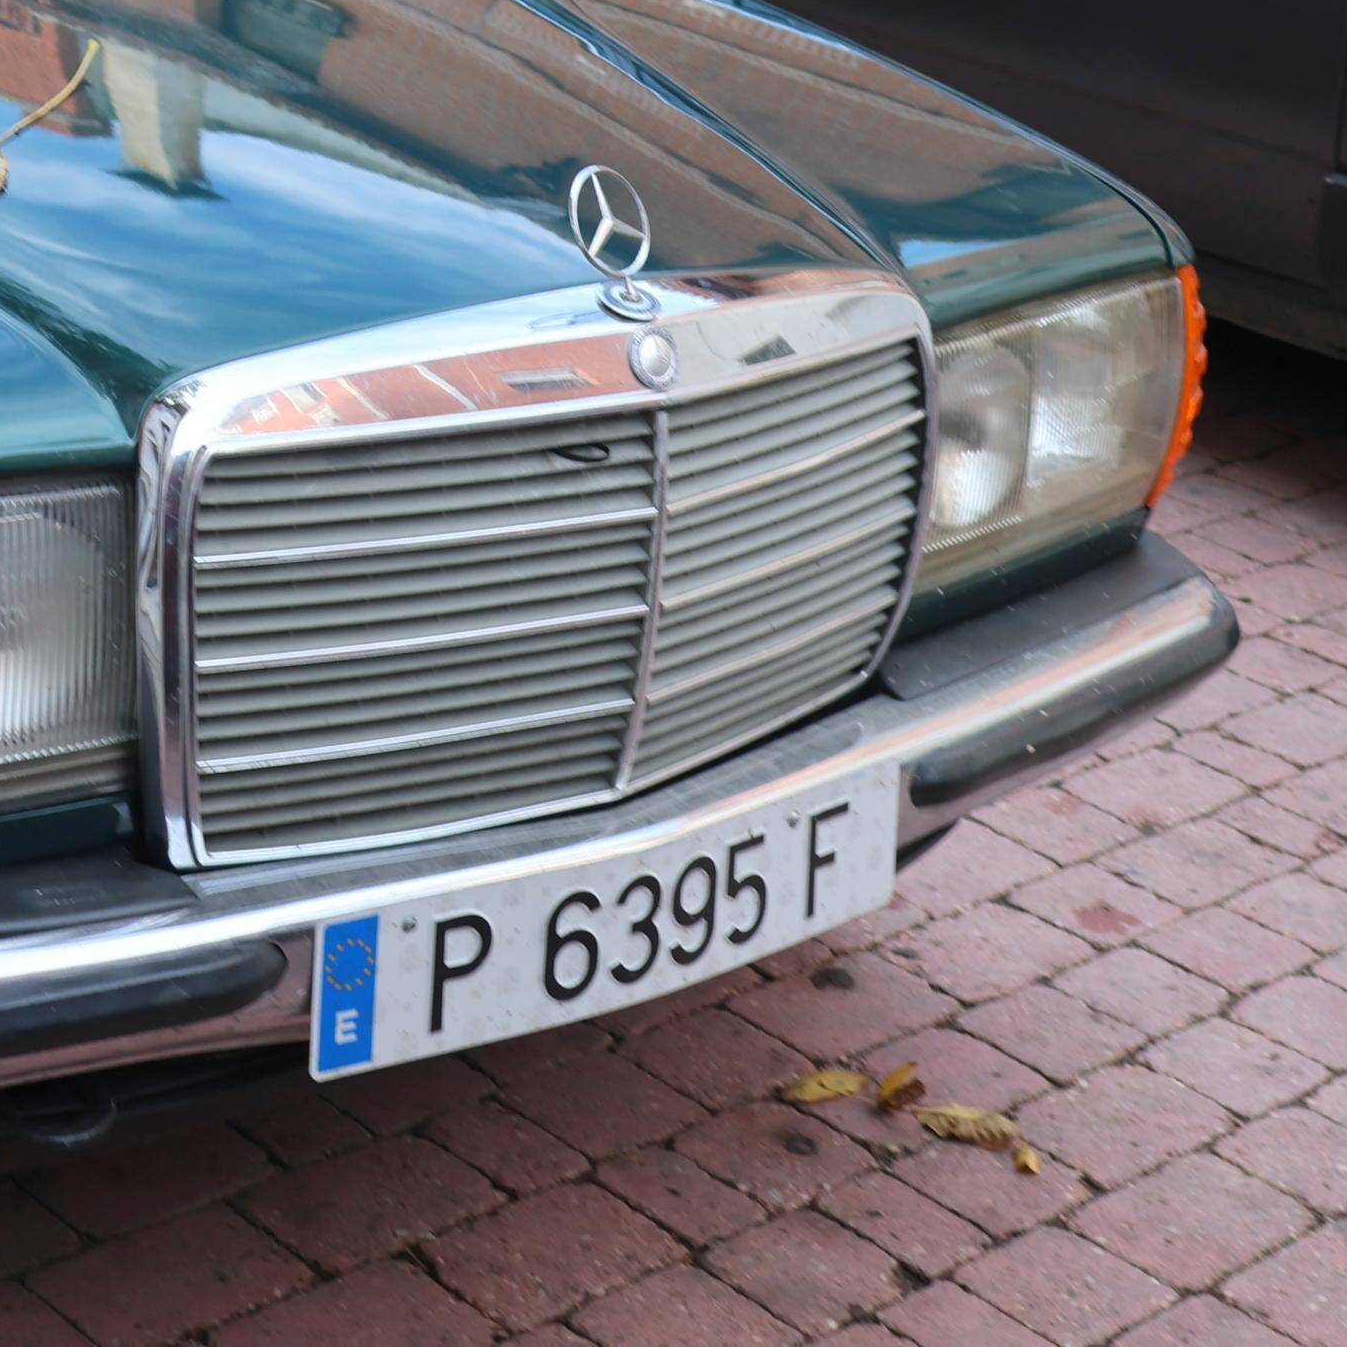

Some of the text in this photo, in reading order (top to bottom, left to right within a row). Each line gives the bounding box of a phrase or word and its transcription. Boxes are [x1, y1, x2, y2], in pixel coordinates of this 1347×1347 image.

[430, 802, 850, 1033] P 6395 F
[334, 1008, 359, 1045] E
